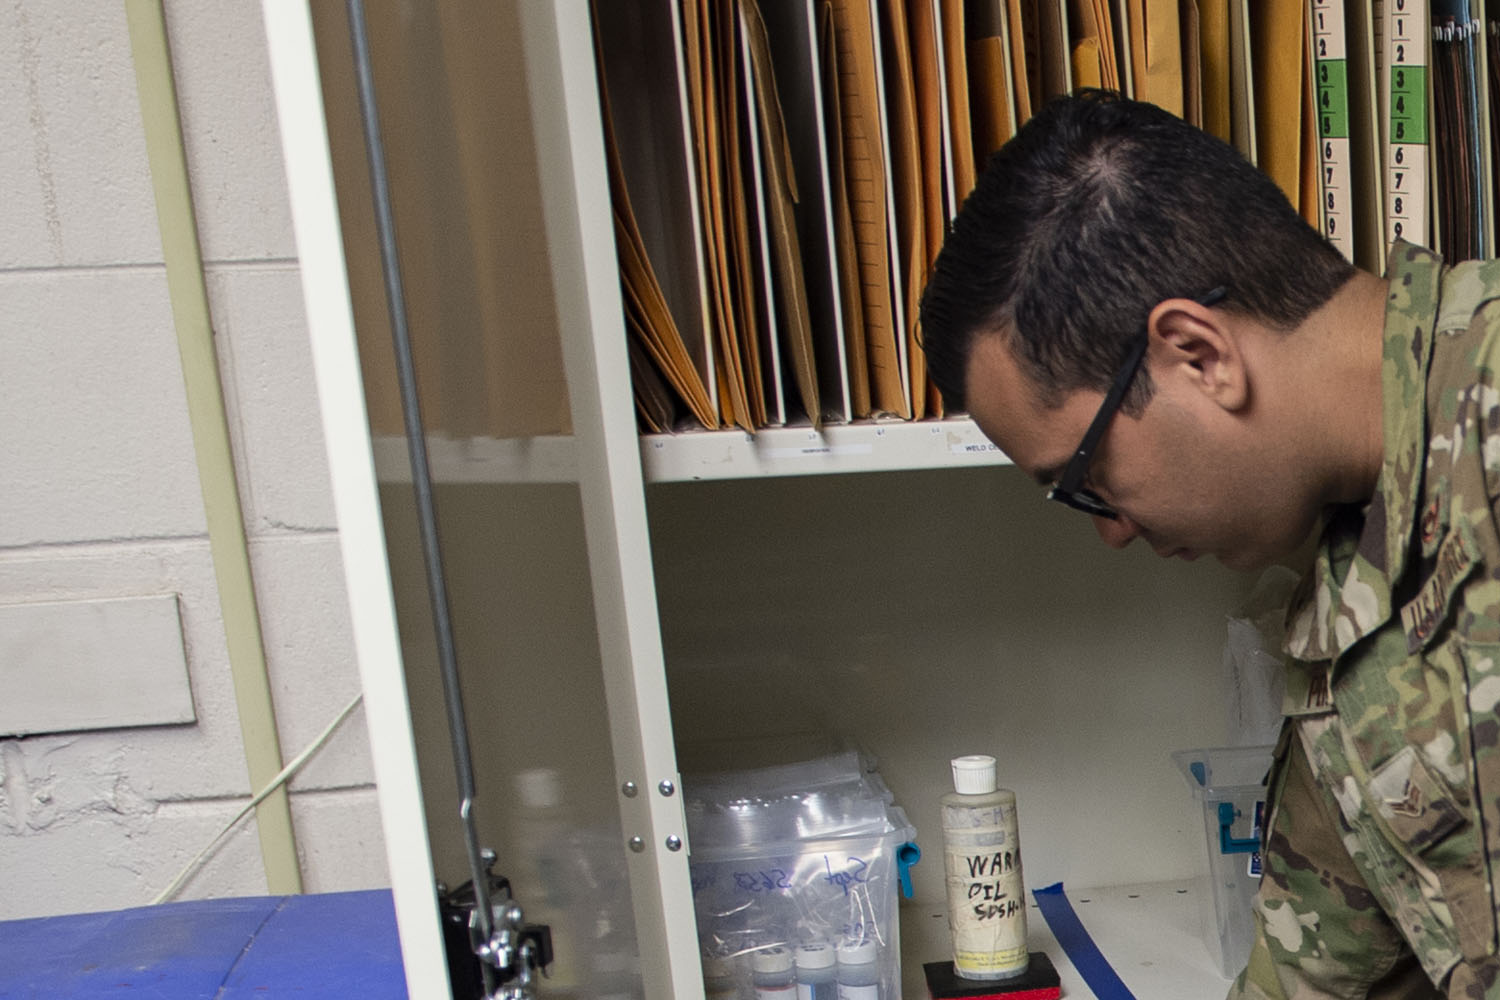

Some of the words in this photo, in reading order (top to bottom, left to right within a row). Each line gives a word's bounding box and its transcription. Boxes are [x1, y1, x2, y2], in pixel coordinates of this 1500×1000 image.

[1318, 13, 1324, 30] 1
[1397, 19, 1403, 36] 1
[1319, 39, 1326, 56] 2
[1397, 45, 1404, 62] 2
[1321, 65, 1328, 83] 3
[1397, 71, 1404, 88] 3
[1322, 91, 1330, 109] 4
[1396, 96, 1404, 114] 4
[1324, 117, 1331, 134] 5
[1396, 122, 1404, 139] 5
[1325, 142, 1332, 159] 6
[1395, 147, 1403, 164] 6
[1326, 168, 1333, 184] 7
[1395, 173, 1403, 189] 7
[1328, 192, 1335, 210] 8
[1395, 197, 1403, 214] 8
[1329, 218, 1336, 234] 9
[1394, 222, 1403, 237] 9
[968, 881, 1007, 902] OIL
